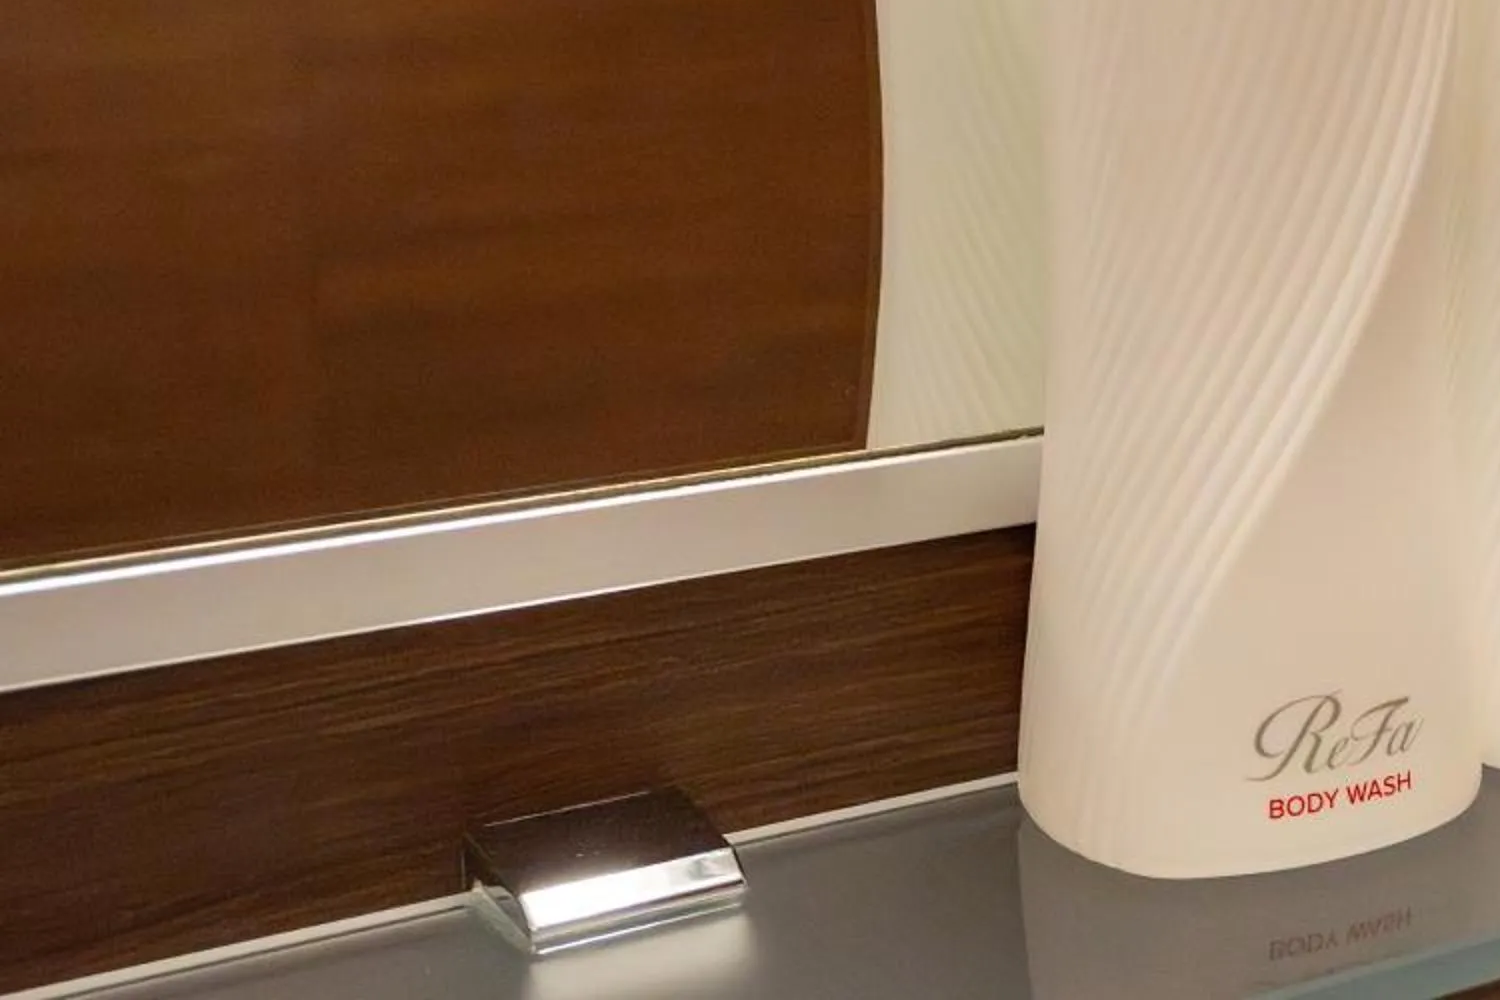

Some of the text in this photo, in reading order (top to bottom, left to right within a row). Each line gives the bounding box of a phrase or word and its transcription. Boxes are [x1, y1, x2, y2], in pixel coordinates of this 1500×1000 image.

[1245, 689, 1424, 782] ReFa
[1268, 769, 1413, 820] BODY WASH
